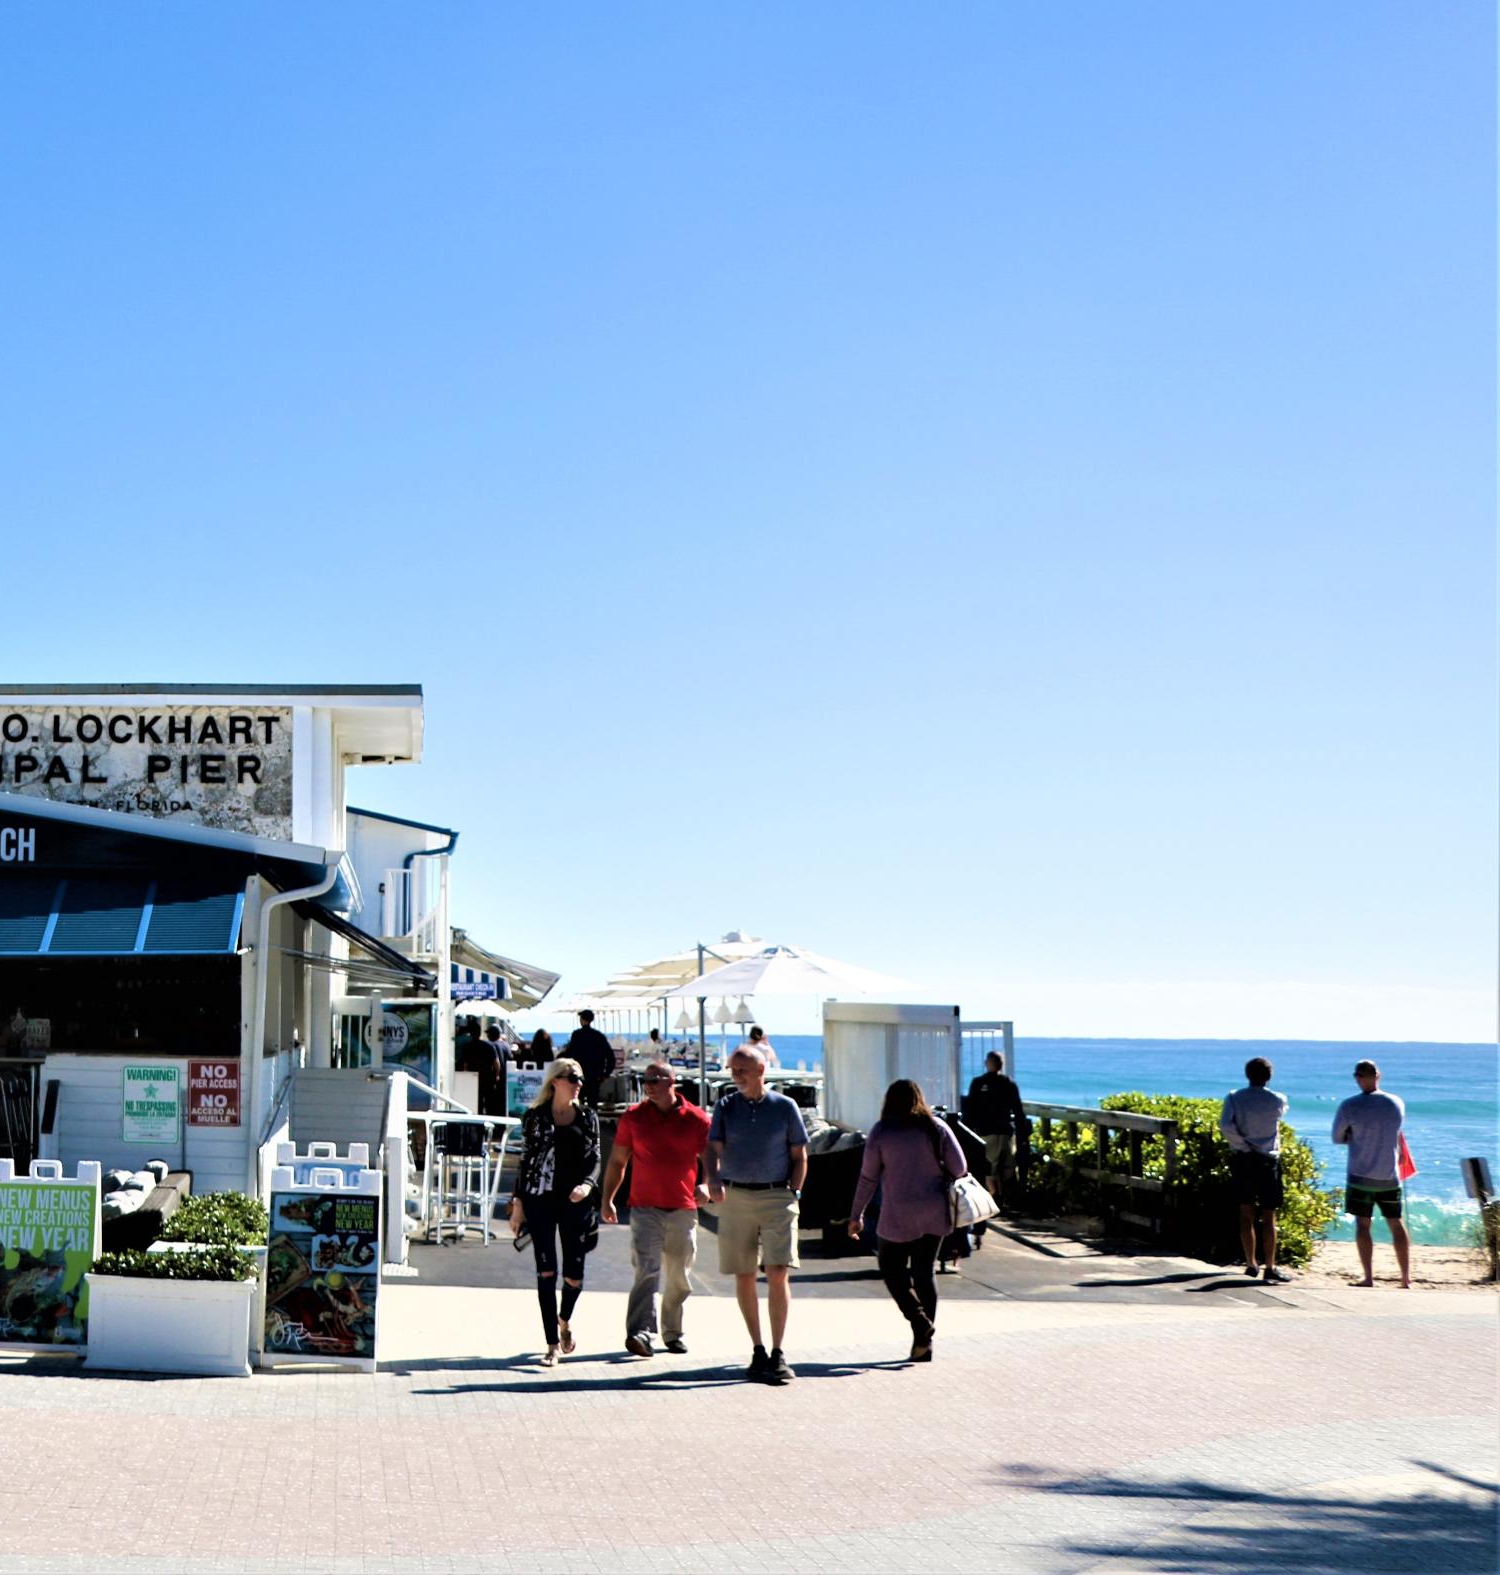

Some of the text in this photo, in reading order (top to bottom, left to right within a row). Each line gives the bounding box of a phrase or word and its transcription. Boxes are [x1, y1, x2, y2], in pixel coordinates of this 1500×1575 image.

[2, 713, 39, 743] O.
[52, 714, 280, 744] LOCKHART
[147, 754, 262, 784] PIER
[115, 800, 193, 813] FLORIDA
[126, 1069, 176, 1081] WARNING!
[201, 1065, 228, 1078] NO
[191, 1079, 237, 1089] PIER ACCESS
[201, 1094, 228, 1107] NO
[36, 1189, 91, 1211] MENUS
[25, 1210, 90, 1227] CREATIONS
[41, 1226, 90, 1252] YEAR
